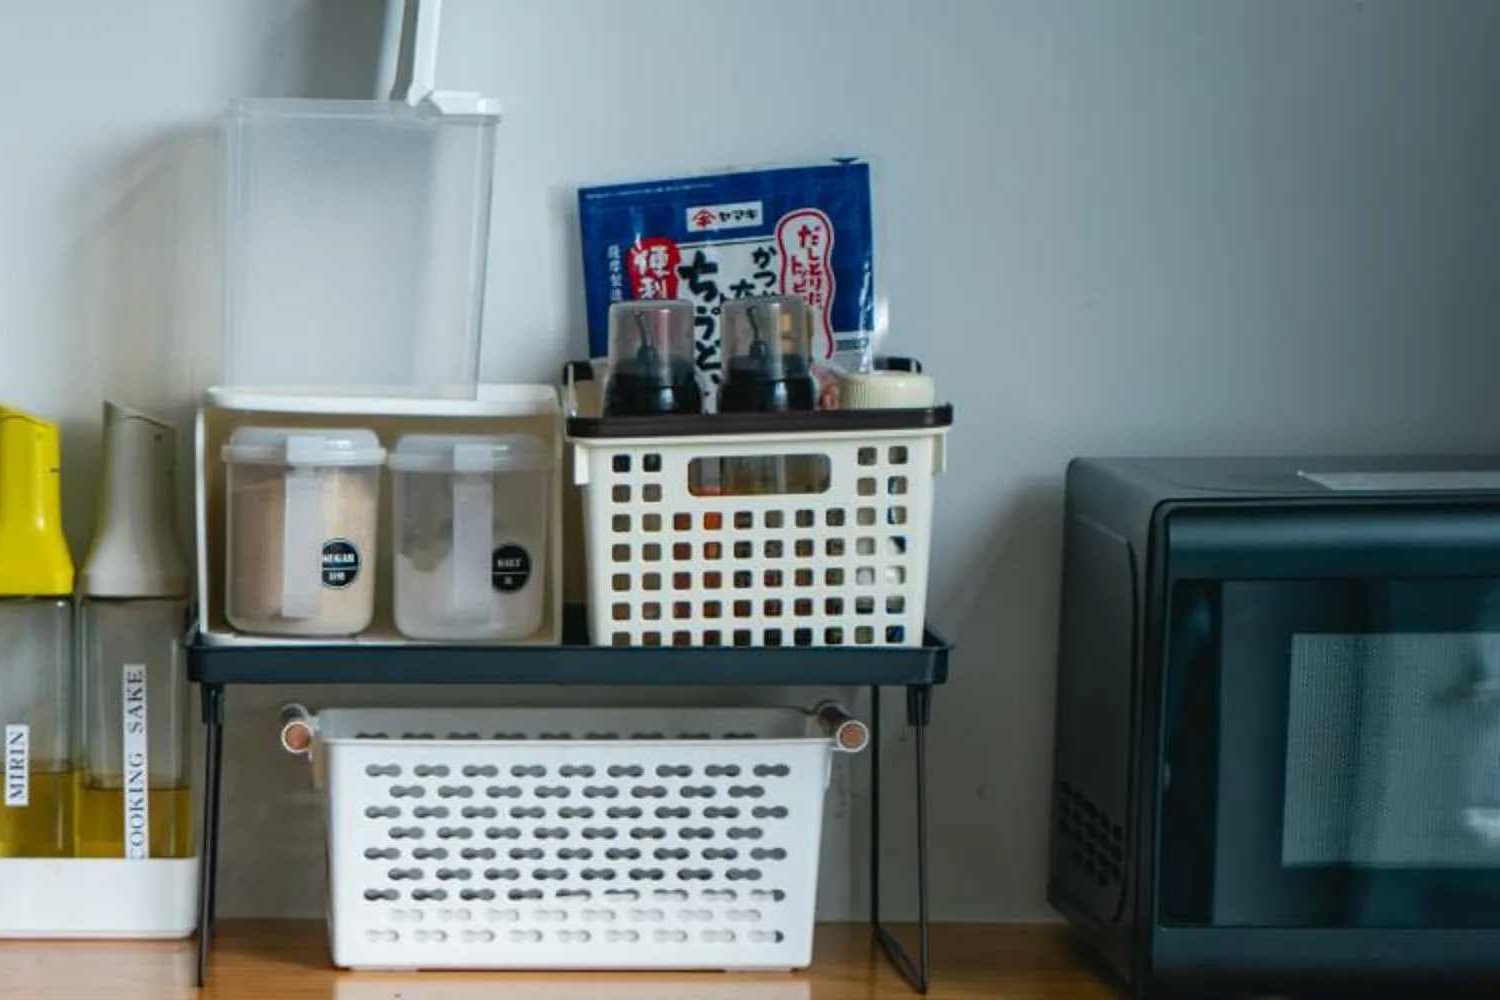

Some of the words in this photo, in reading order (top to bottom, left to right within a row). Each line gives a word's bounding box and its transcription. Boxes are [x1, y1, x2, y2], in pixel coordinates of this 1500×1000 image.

[718, 207, 758, 222] ヤマキ
[752, 246, 778, 297] かつ
[125, 671, 144, 733] SAKE
[8, 730, 25, 802] MIRIN
